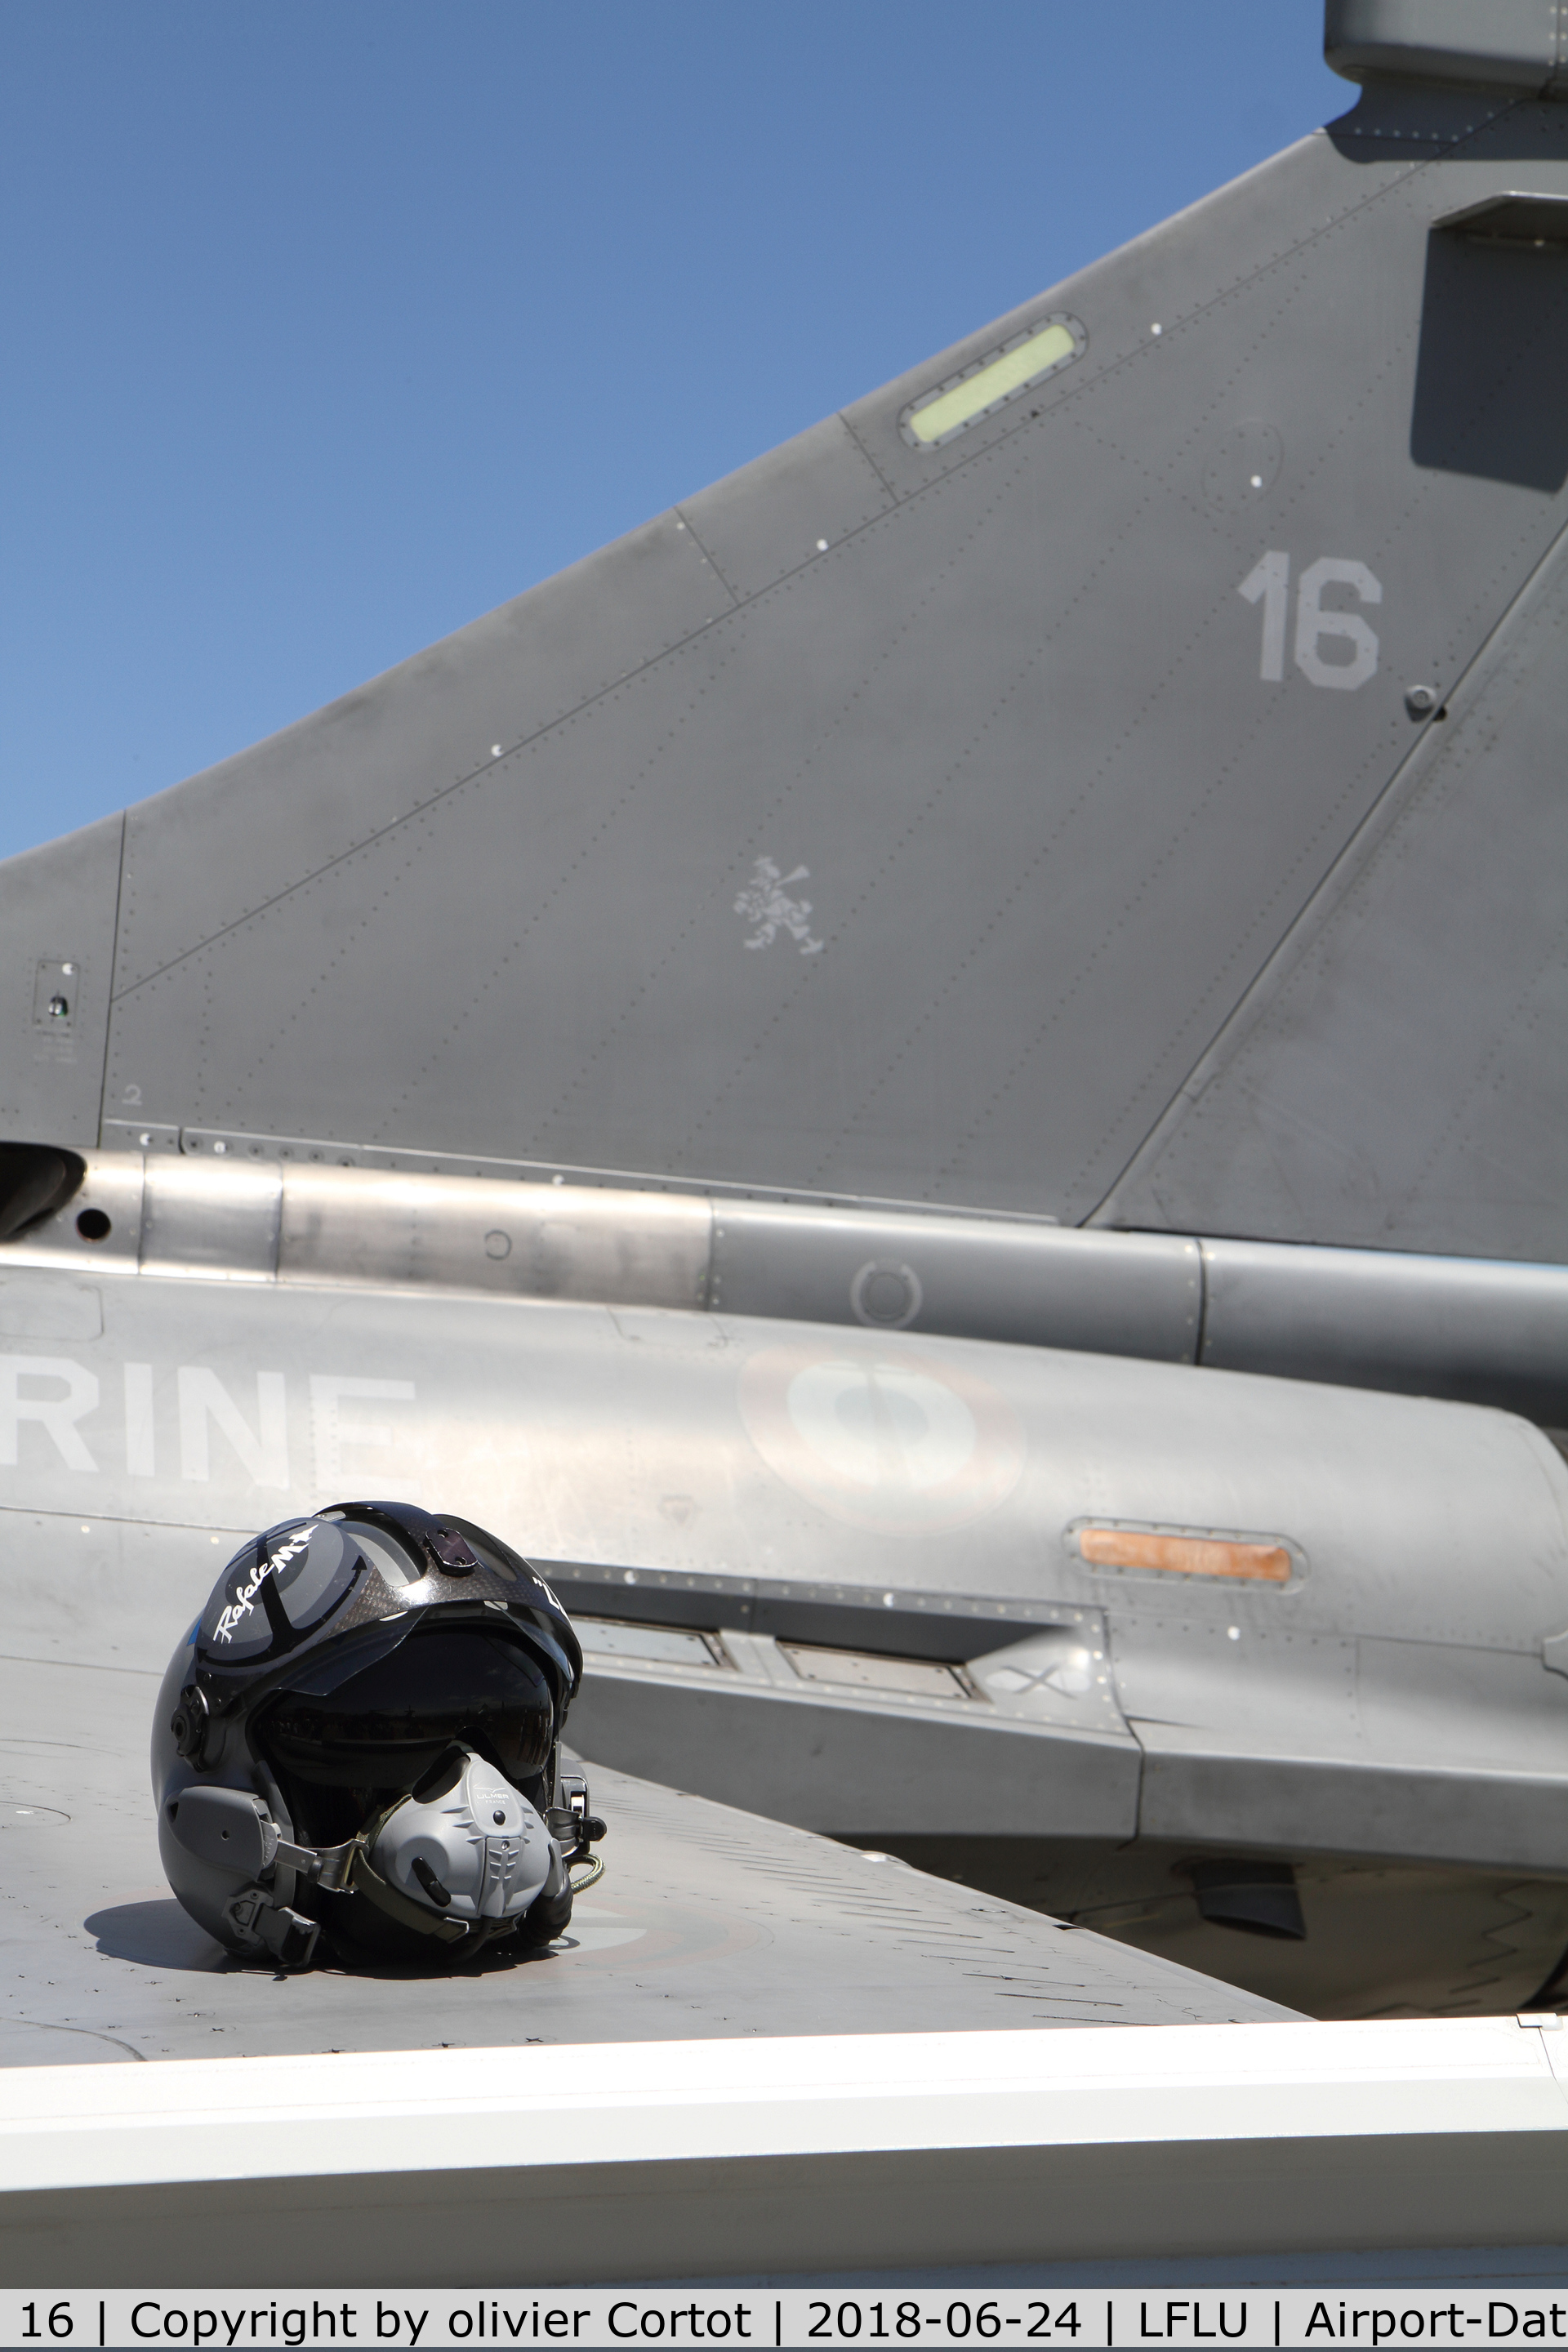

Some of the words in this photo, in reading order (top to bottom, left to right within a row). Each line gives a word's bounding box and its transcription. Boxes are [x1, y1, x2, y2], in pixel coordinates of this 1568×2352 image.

[1237, 550, 1382, 691] 16
[0, 1353, 421, 1494] RINE
[212, 1562, 275, 1644] Rafale
